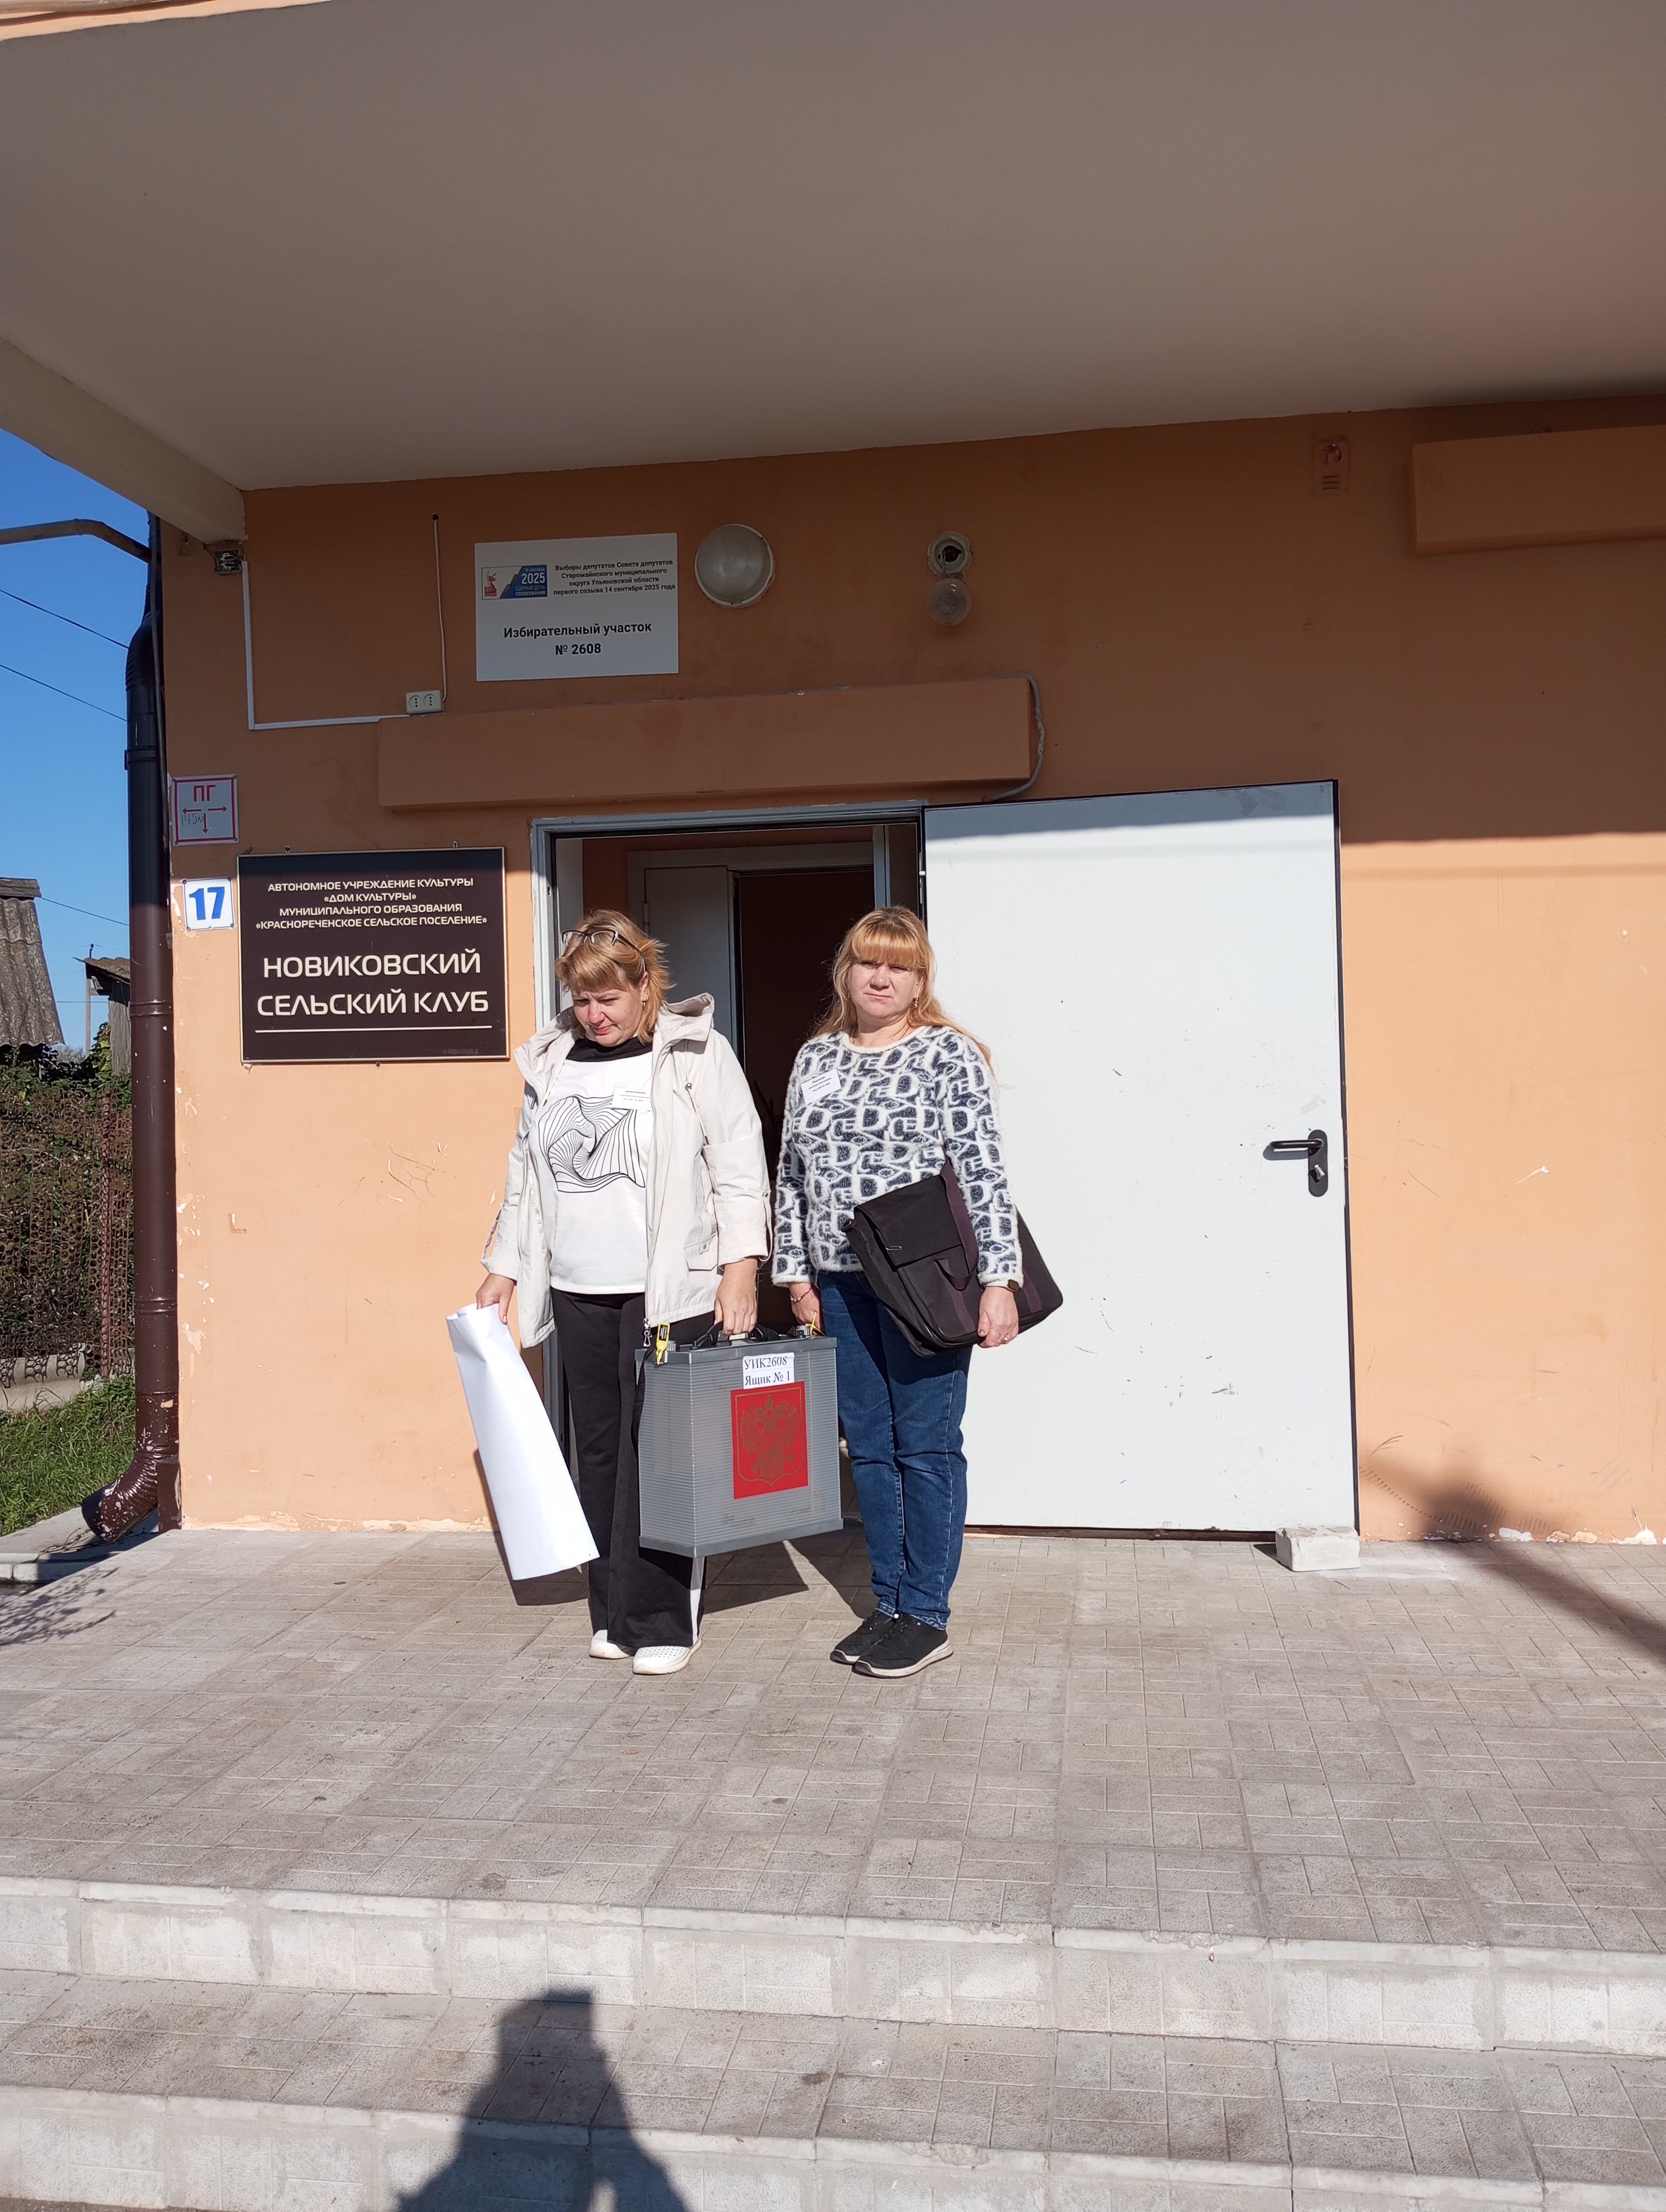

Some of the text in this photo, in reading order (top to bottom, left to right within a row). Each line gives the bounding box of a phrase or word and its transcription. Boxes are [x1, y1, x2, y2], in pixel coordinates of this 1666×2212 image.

[522, 573, 545, 584] 2025
[561, 570, 613, 578] Старомайнского
[592, 577, 632, 586] Ульяновской
[504, 622, 652, 639] Избирательный участок
[555, 643, 601, 655] № 2608
[193, 785, 216, 802] ПГ
[268, 878, 473, 891] АВТОНОМНОЕ УЧРЕЖДЕНИЕ КУЛЬТУРЫ
[189, 887, 225, 921] 17
[324, 892, 416, 903] «ДОМ КУЛЬТУРЫ»
[279, 904, 462, 917] МУНИЦИПАЛЬНОГО ОБРАЗОВАНИЯ
[256, 915, 487, 929] «КРАСНОРЕЧЕНСКОЕ СЕЛЬСКОЕ ПОСЕЛЕНИЕ»
[264, 948, 480, 978] НОВИКОВСКИЙ
[258, 988, 489, 1016] СЕЛЬСКИЙ КЛУБ
[745, 1356, 787, 1369] УИК2608
[745, 1371, 790, 1386] Ящик № 1
